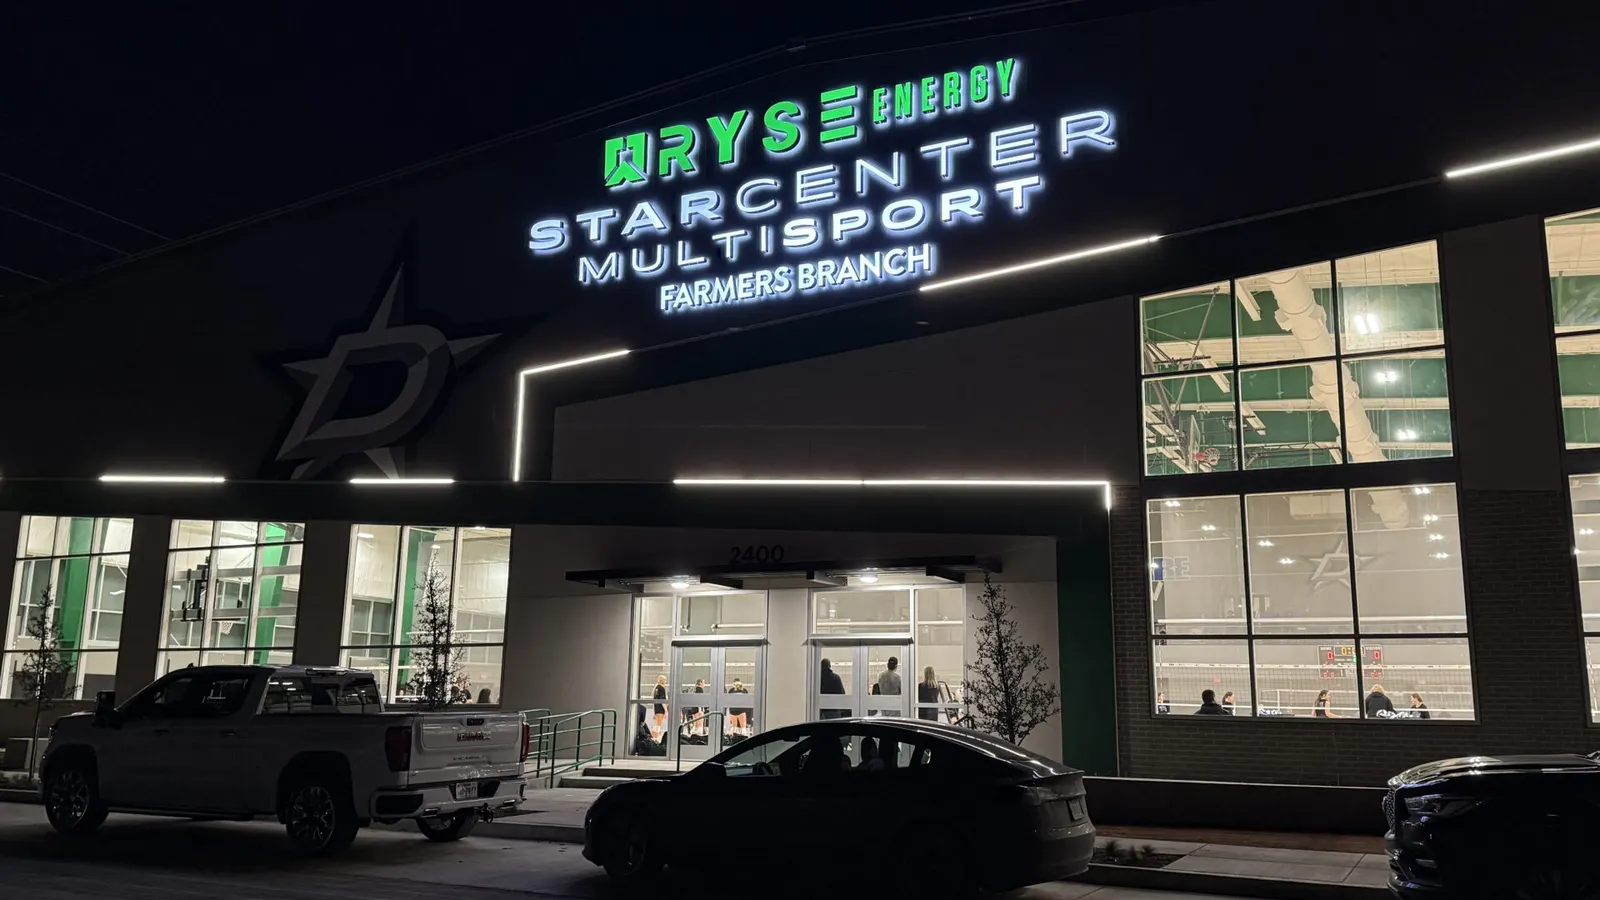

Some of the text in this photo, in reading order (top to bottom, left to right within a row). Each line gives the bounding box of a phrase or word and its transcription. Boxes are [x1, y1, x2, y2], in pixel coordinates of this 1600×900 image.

[659, 58, 1017, 177] RYSE ENERGY
[528, 110, 1117, 251] STARCENTER
[578, 176, 1042, 284] MULTISPORT
[660, 243, 934, 312] FARMERS BRANCH
[731, 544, 784, 565] 2400
